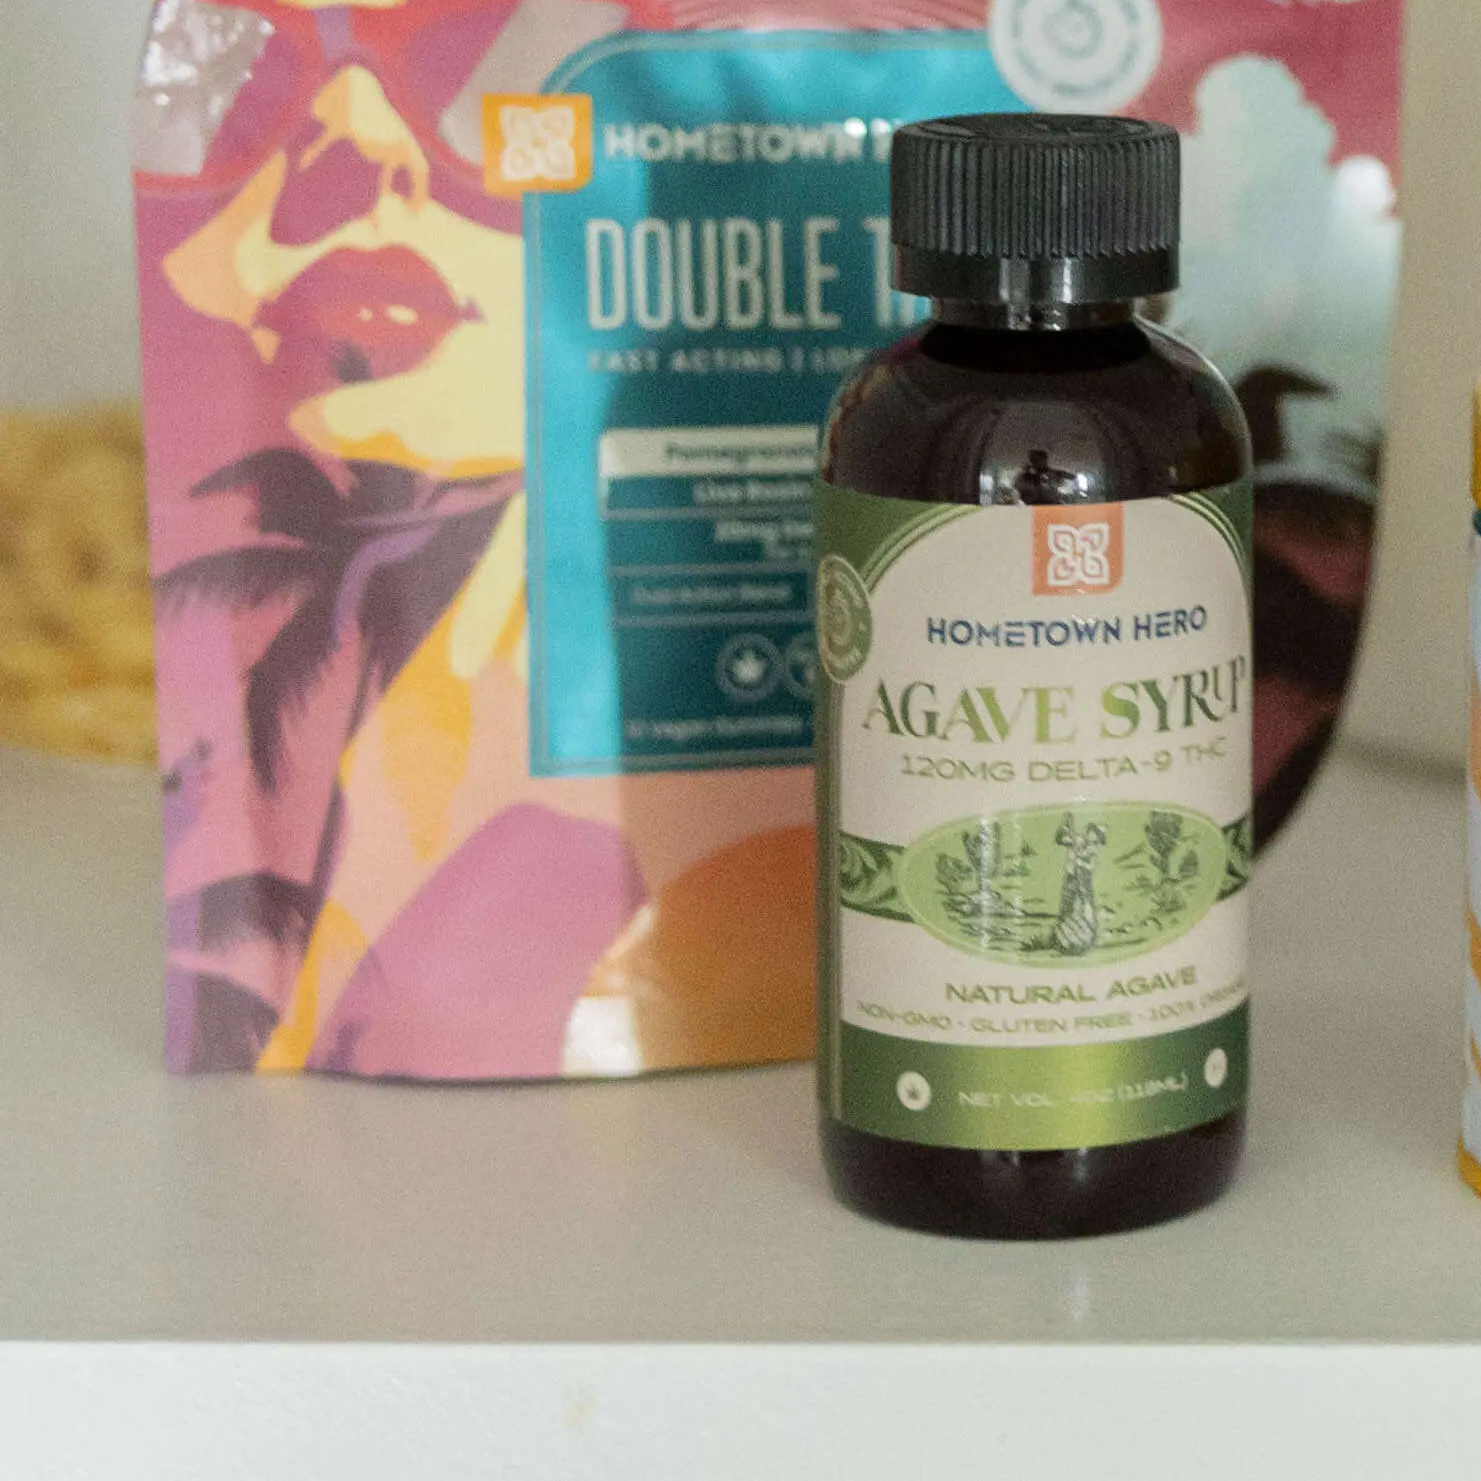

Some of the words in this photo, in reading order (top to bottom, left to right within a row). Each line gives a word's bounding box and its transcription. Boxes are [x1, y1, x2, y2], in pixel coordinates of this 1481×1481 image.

[603, 122, 864, 164] HOMETOWN
[585, 216, 842, 331] DOUBLE
[926, 615, 1122, 648] HOMETOWN
[1133, 605, 1208, 642] HERO
[861, 679, 1076, 744] AGAVE
[1100, 655, 1247, 741] SYRUP
[900, 754, 1015, 782] 120MG
[1028, 749, 1173, 782] DELTA-9
[1181, 737, 1229, 764] THC
[946, 982, 1096, 1006] NATURAL
[1105, 966, 1198, 1000] AGAVE
[856, 999, 953, 1031] NON-GMO
[970, 1017, 1068, 1034] GLUTEN
[1073, 1010, 1133, 1030] FREE
[958, 1090, 1004, 1108] NET
